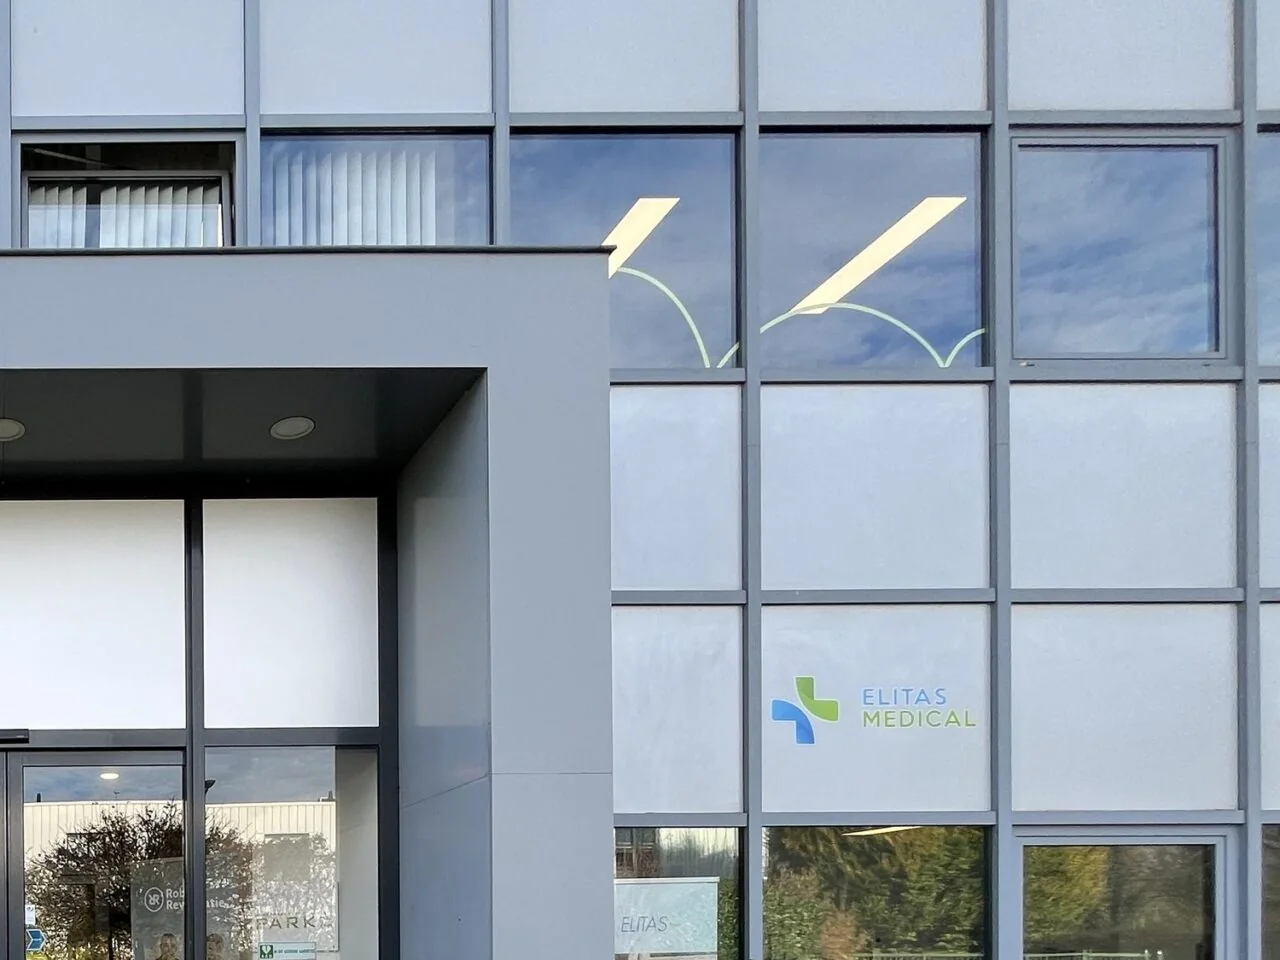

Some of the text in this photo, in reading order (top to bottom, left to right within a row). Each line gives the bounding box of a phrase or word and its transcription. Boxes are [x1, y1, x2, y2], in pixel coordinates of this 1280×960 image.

[862, 688, 947, 706] ELITAS
[863, 710, 977, 728] MEDICAL
[621, 915, 669, 933] ELITAS
